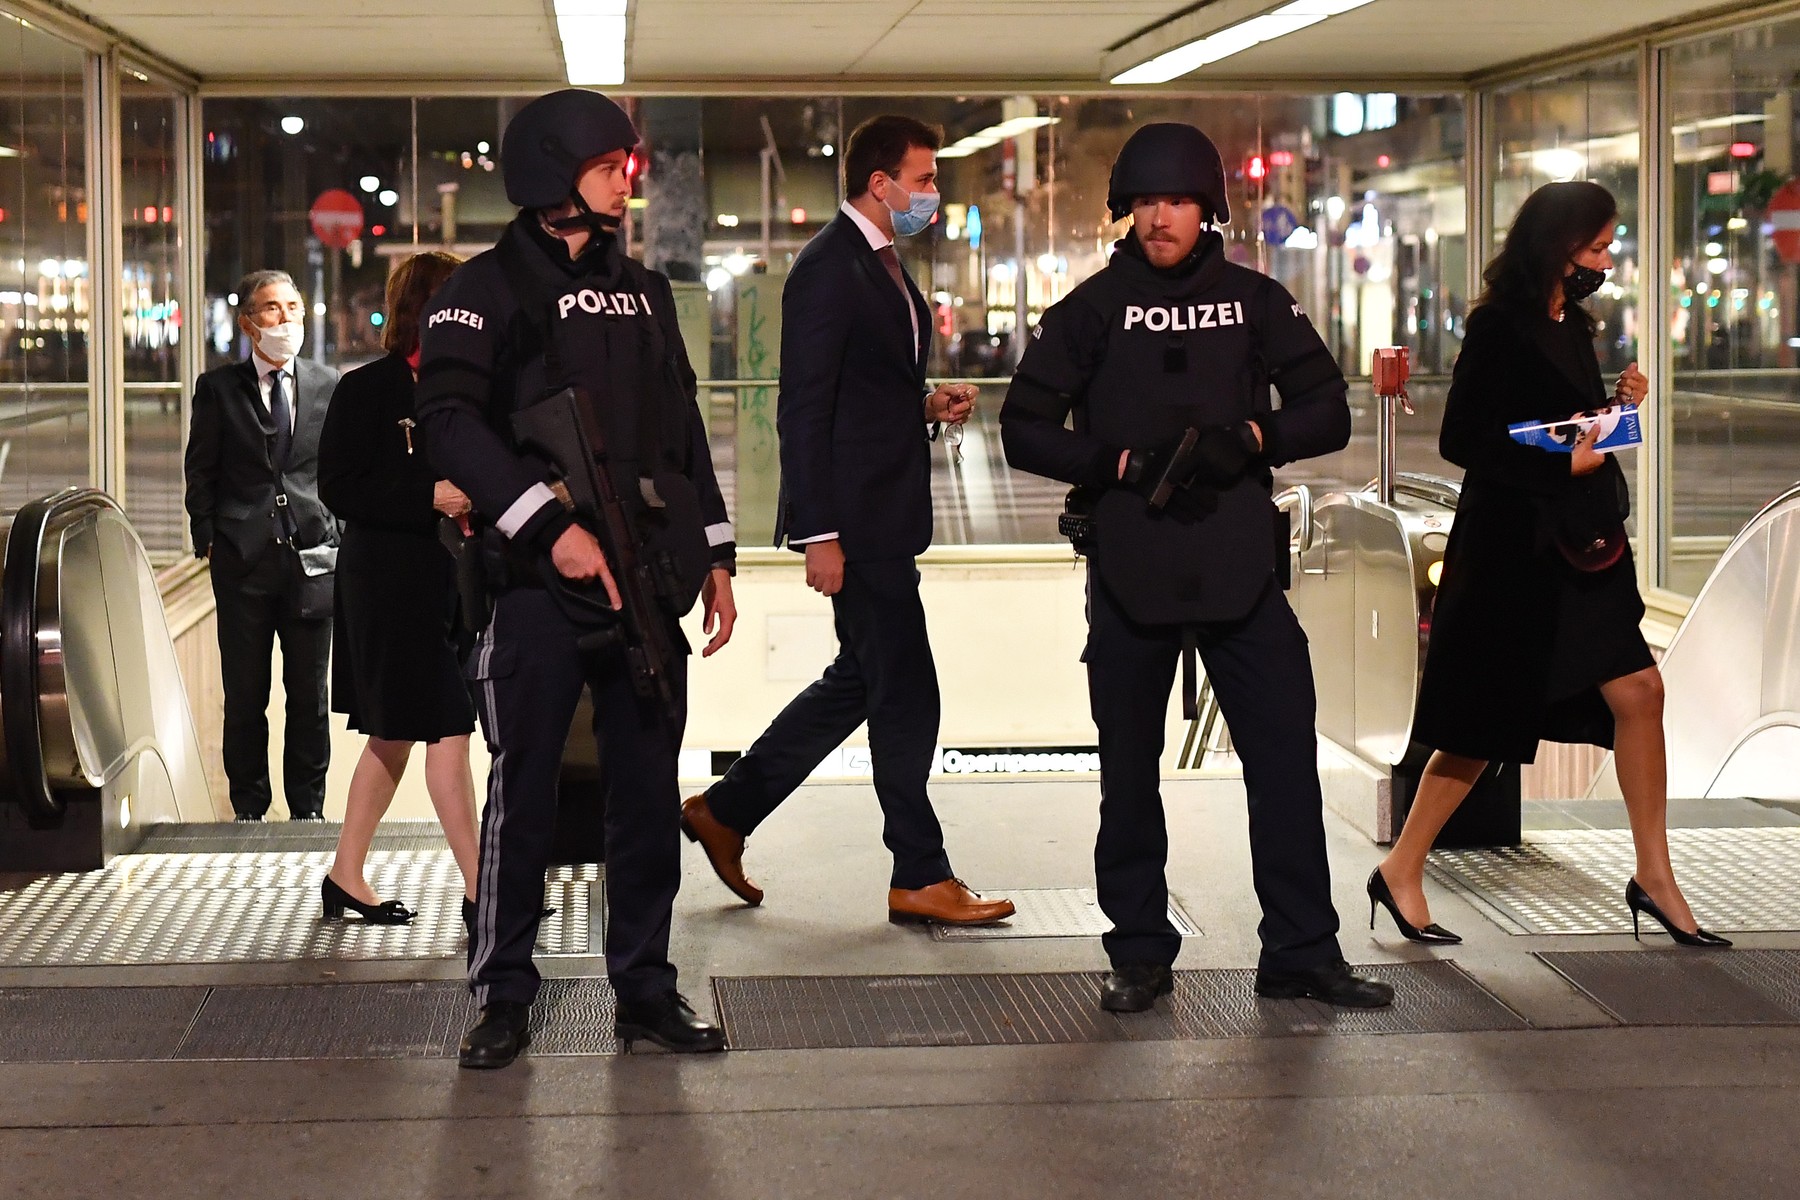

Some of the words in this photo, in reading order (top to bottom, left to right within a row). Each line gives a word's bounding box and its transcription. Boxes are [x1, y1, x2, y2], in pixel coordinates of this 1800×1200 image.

[558, 289, 652, 319] POLIZI
[1124, 302, 1243, 331] POLIZEI
[429, 309, 483, 330] POLIZEI
